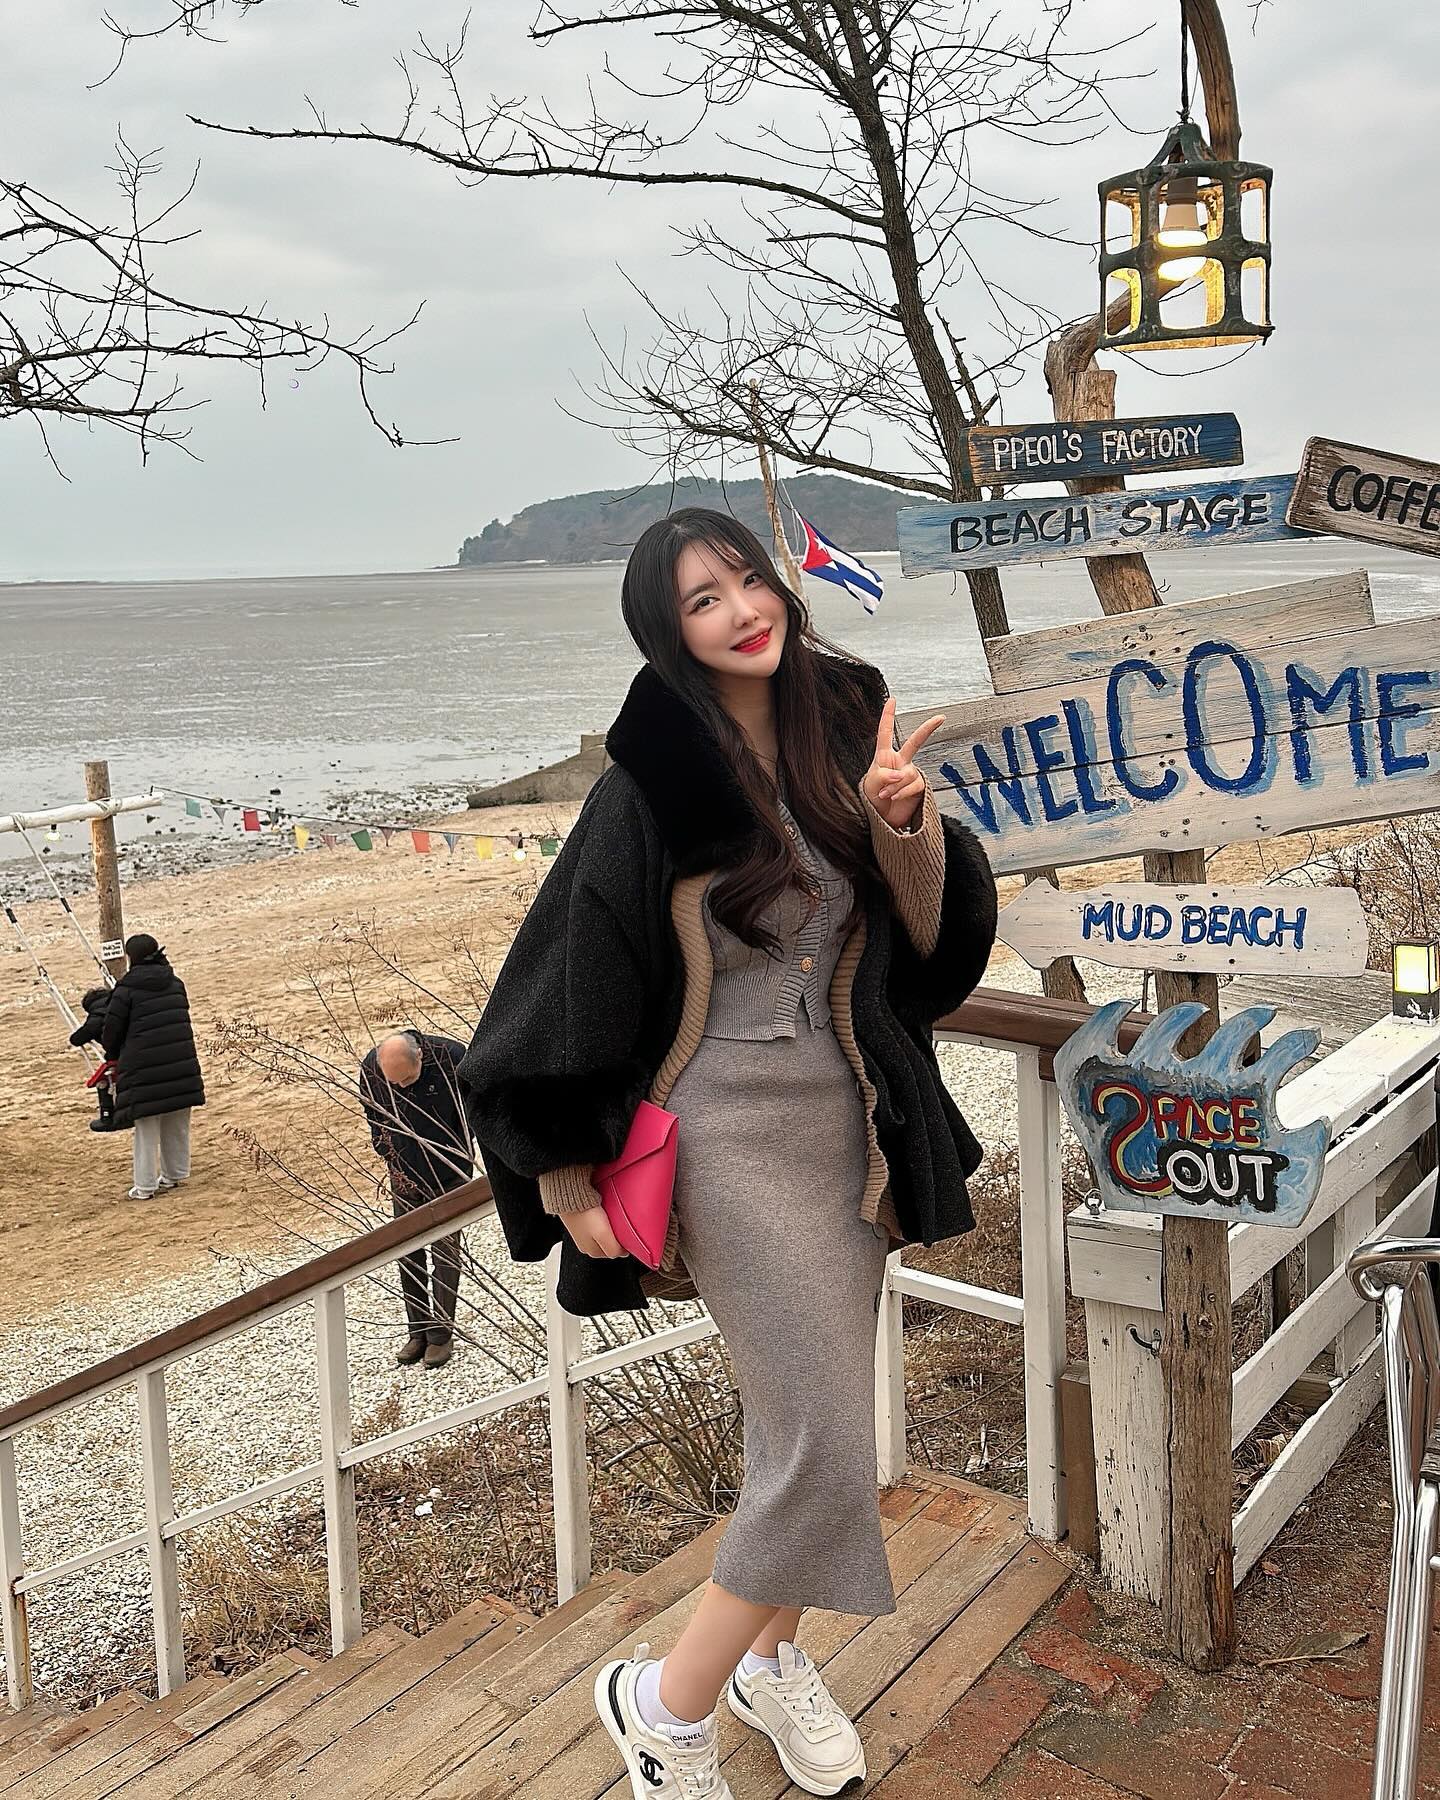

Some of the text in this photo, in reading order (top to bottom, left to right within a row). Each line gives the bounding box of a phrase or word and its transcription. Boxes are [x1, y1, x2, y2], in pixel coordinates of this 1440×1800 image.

[992, 424, 1203, 472] PPEOL'S FACTORY
[950, 493, 1271, 554] BEACH STAGE
[938, 639, 1440, 835] WELCOME
[1082, 901, 1307, 950] MUD BEACH
[1166, 1149, 1273, 1202] OUT
[671, 1732, 703, 1741] CHANEL
